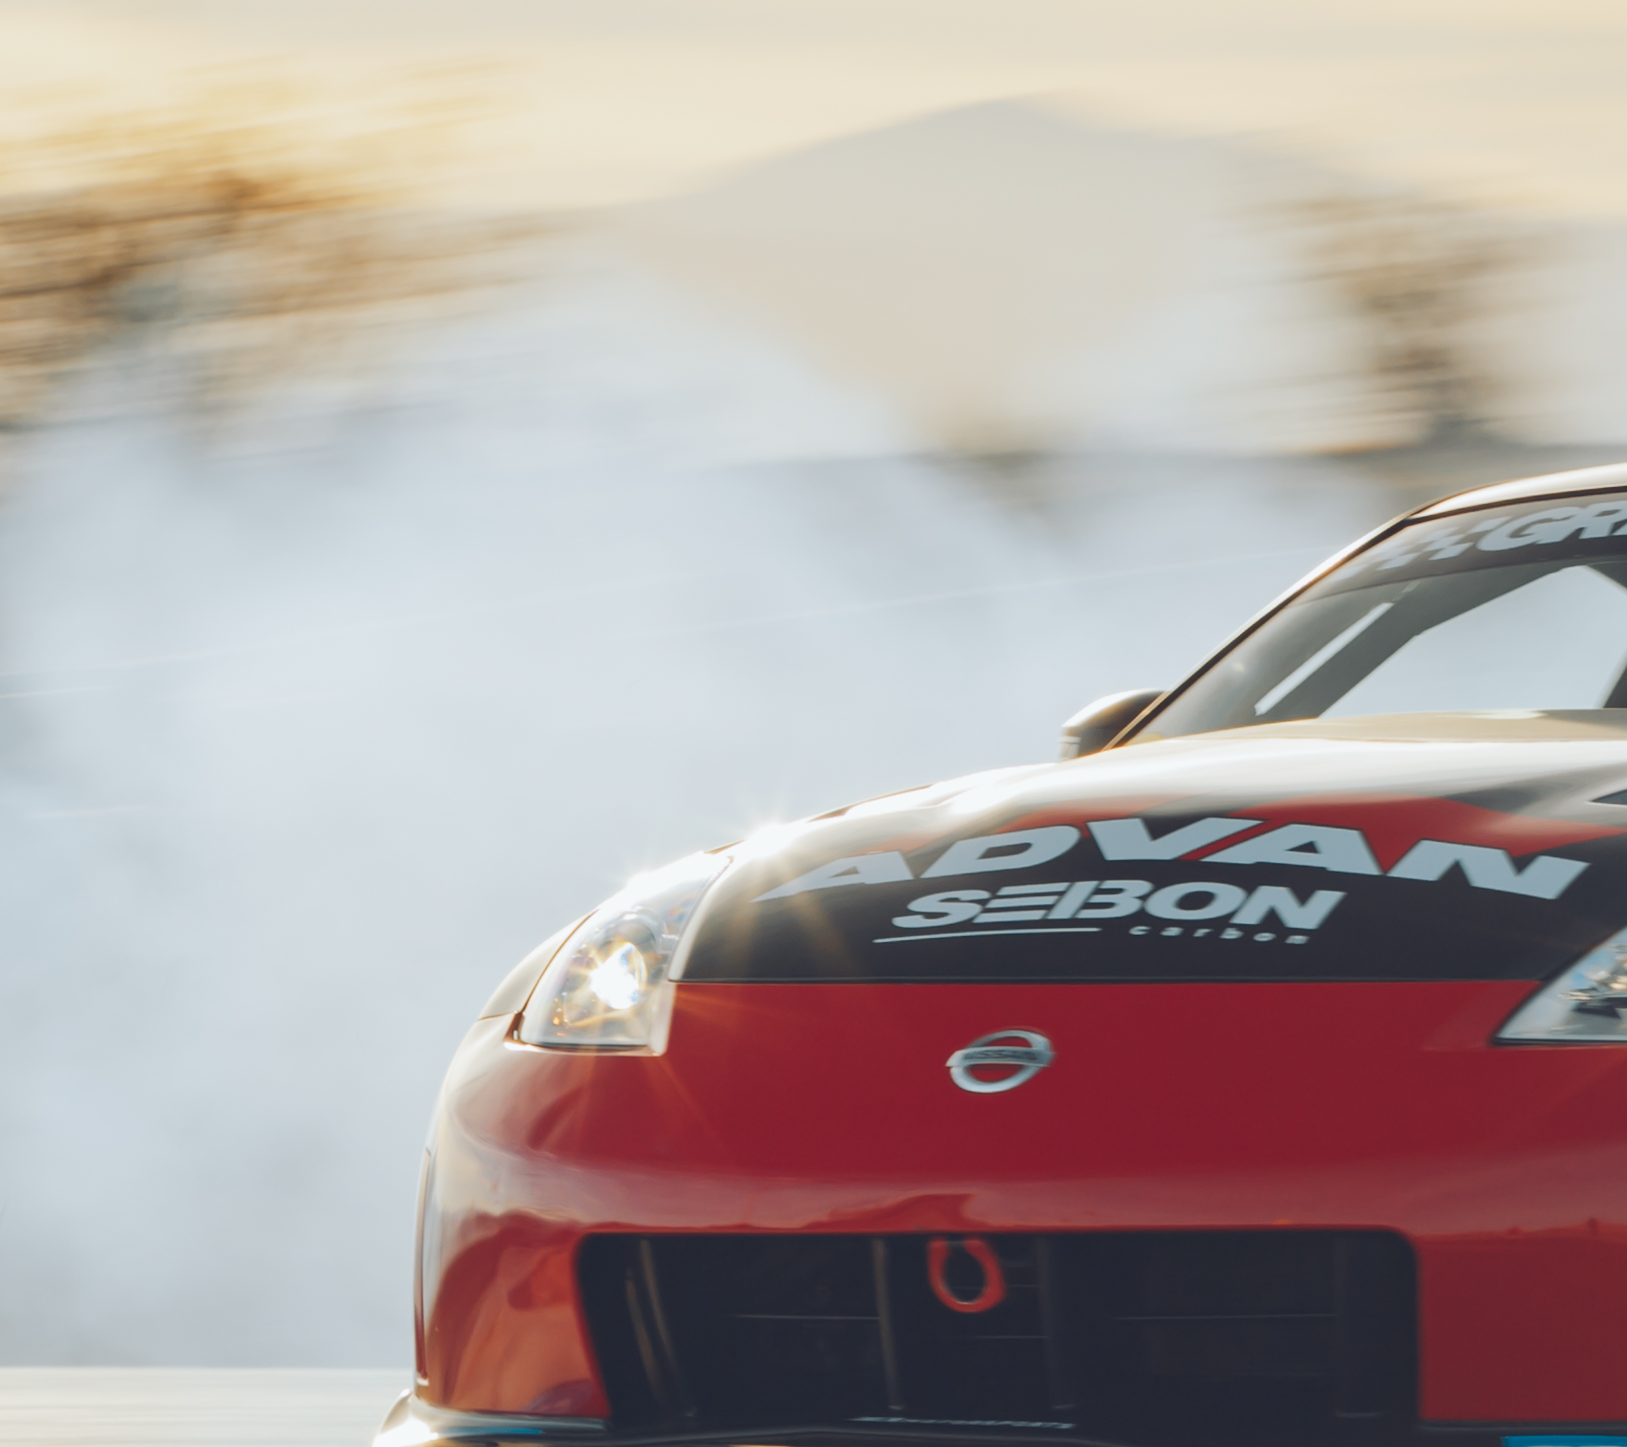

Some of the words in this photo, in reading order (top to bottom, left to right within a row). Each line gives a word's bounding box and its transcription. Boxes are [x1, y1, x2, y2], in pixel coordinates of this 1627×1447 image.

[749, 817, 1590, 900] ADVAN
[891, 879, 1346, 930] SEBON
[1128, 925, 1311, 945] carbon
